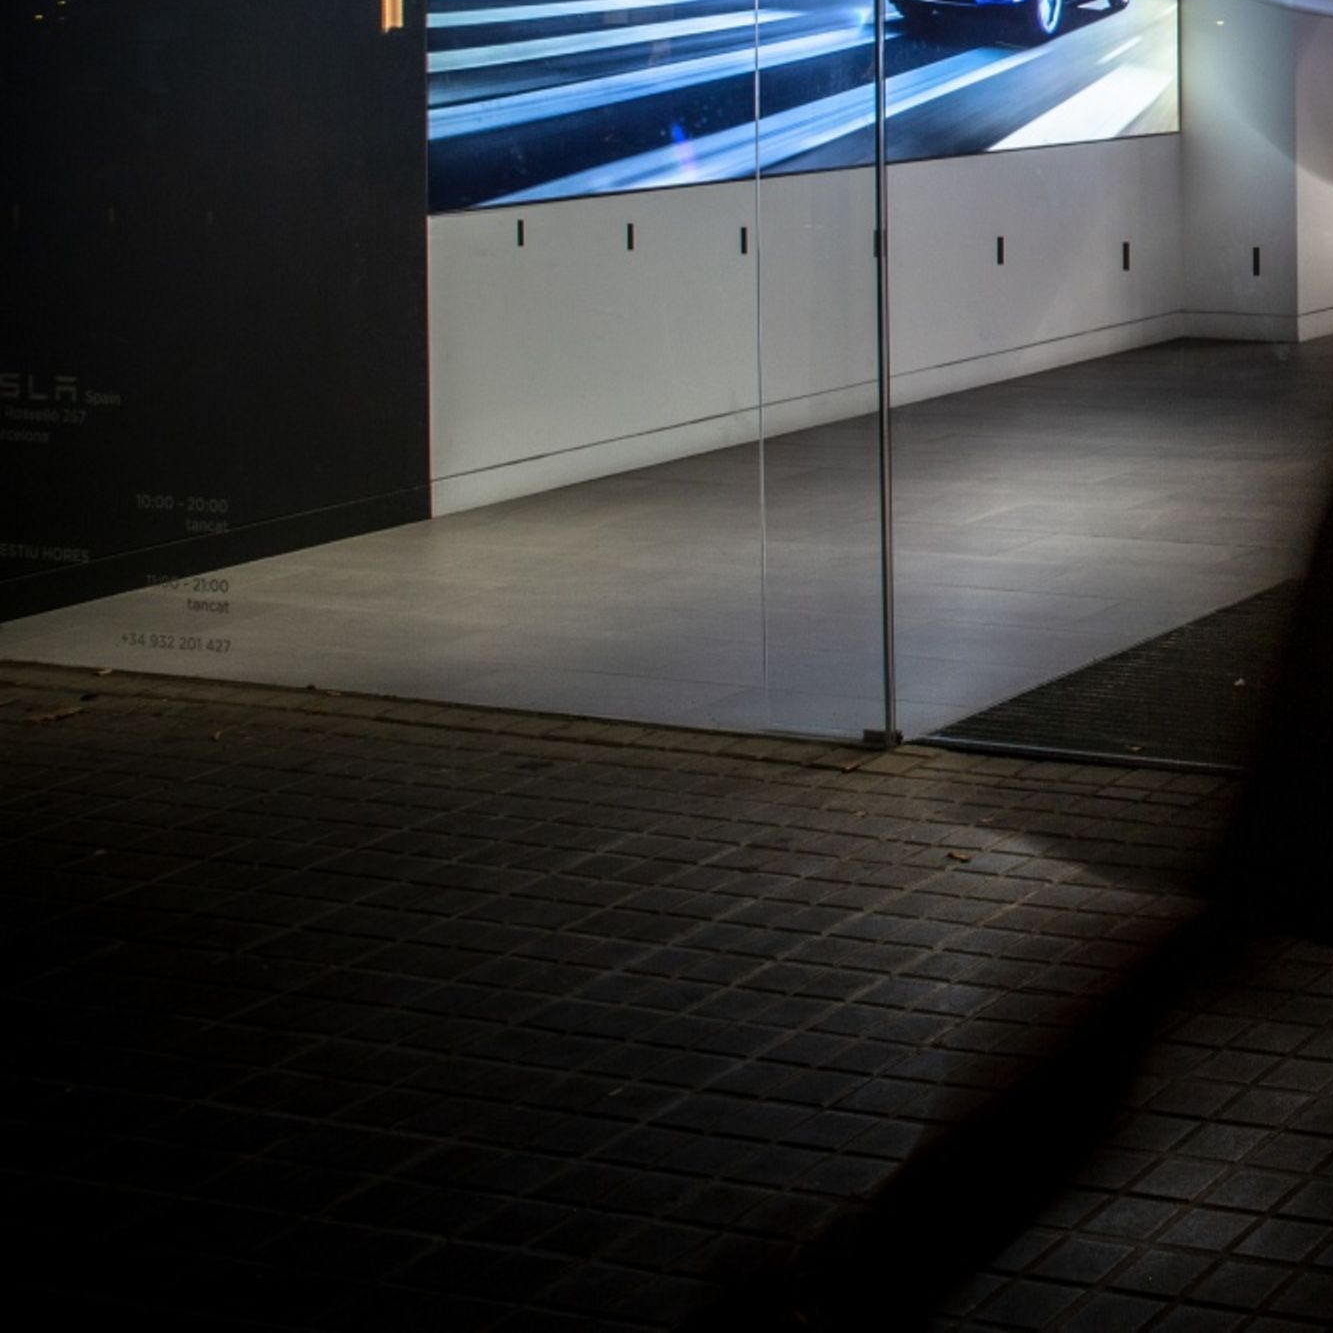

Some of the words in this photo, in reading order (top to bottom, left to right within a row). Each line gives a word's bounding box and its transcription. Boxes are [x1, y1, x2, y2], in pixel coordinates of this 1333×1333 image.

[84, 389, 120, 407] Spain
[136, 493, 175, 511] 10:00
[187, 496, 229, 514] 20:00
[185, 518, 231, 534] tancat
[40, 546, 89, 564] HORES
[192, 578, 230, 594] 21:00
[186, 597, 230, 614] tancat
[121, 633, 145, 647] +34
[151, 634, 175, 649] 932
[180, 637, 201, 652] 201
[205, 639, 231, 654] 427
